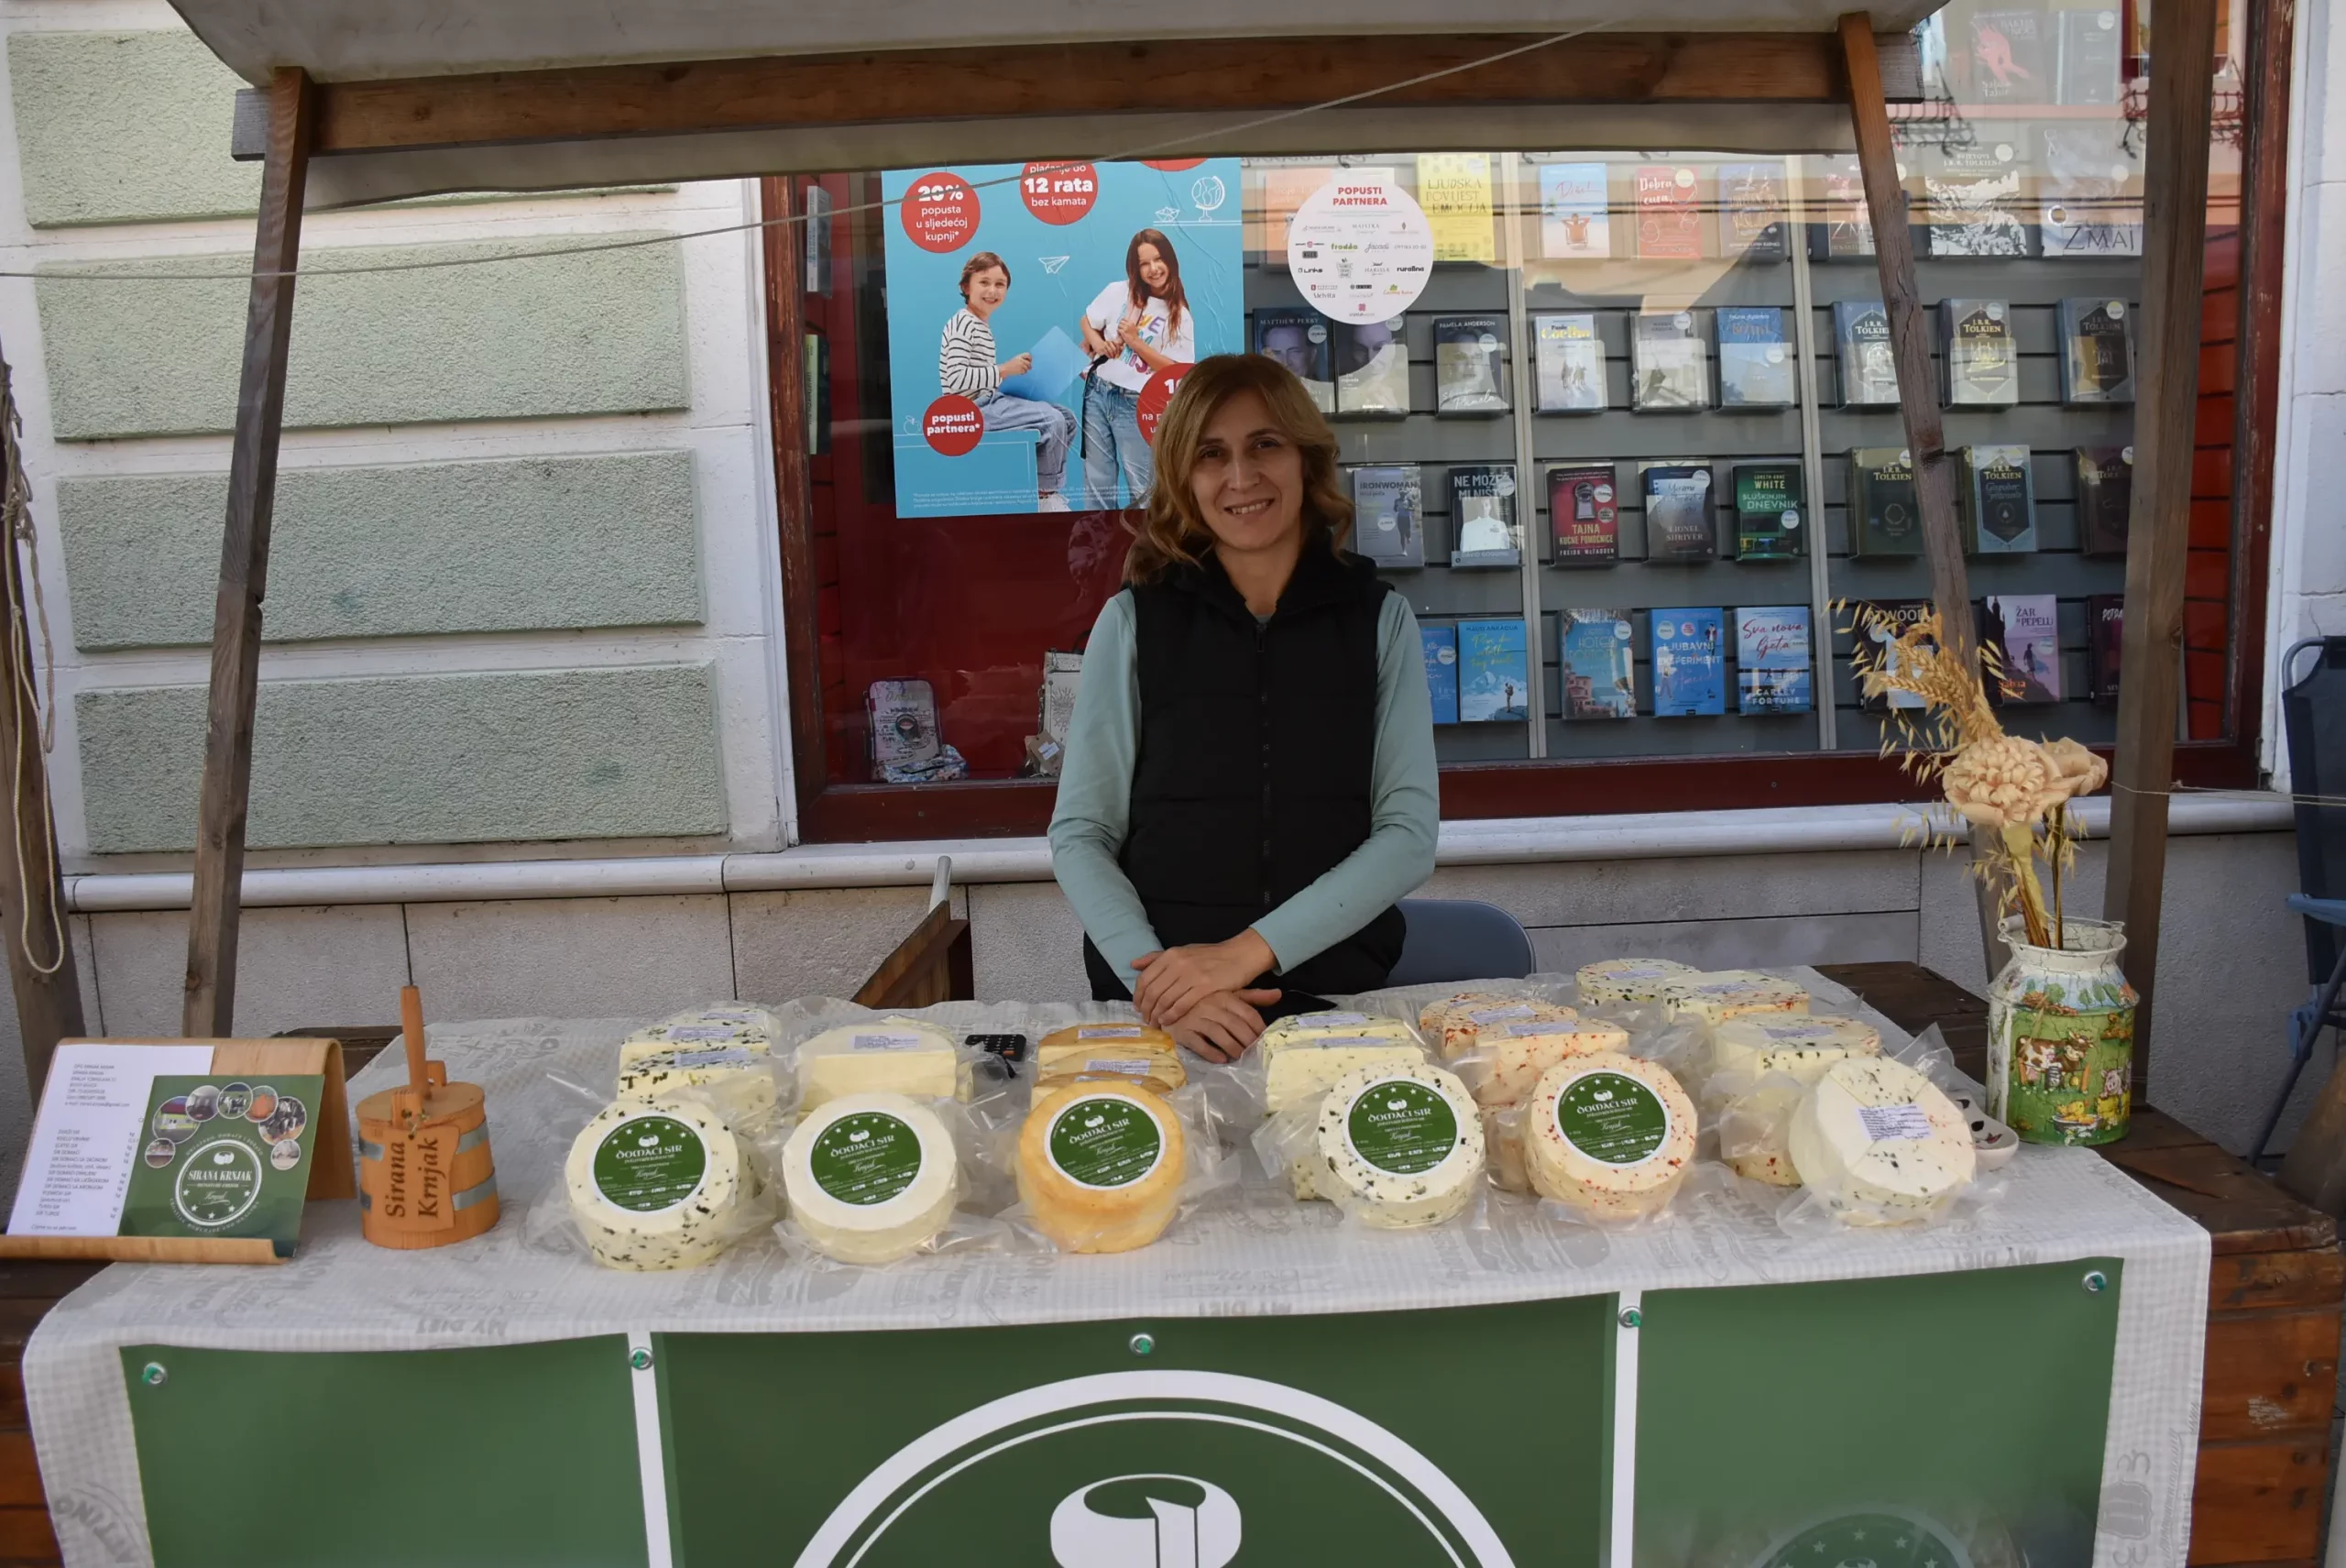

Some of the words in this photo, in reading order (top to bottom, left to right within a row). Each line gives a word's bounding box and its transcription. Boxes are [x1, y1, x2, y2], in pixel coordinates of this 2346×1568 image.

[1025, 178, 1048, 193] 12
[1054, 179, 1094, 194] rata
[1639, 177, 1672, 192] Dobra
[1337, 186, 1382, 195] POPUSTI
[1031, 196, 1049, 207] bez
[1051, 196, 1087, 207] kamata
[1332, 197, 1387, 206] PARTNERA
[921, 206, 961, 217] popusta
[915, 220, 923, 228] u
[924, 216, 968, 230] sljedećoj
[2063, 225, 2135, 252] ZMAJ
[1963, 324, 2001, 333] TOLKIEN
[931, 411, 975, 425] popusti
[1453, 475, 1470, 488] NE
[1873, 472, 1913, 481] TOLKIEN
[1983, 471, 2023, 481] TOLKIEN
[1359, 480, 1418, 490] IRONWOMAN
[1754, 479, 1786, 490] WHITE
[1742, 491, 1787, 501] SLUŠKINJIN
[1747, 500, 1799, 510] DNEVNIK
[1571, 523, 1601, 535] TAJNA
[1668, 524, 1699, 533] LIONEL
[1665, 533, 1705, 543] SHRIVER
[2016, 605, 2036, 618] ŽAR
[2021, 617, 2055, 628] PEPELU
[1742, 618, 1769, 640] Sva
[1771, 622, 1804, 632] nova
[1751, 696, 1801, 706] FORTUNE
[1619, 1097, 1639, 1107] SIR
[1412, 1107, 1433, 1116] SIR
[1112, 1117, 1131, 1129] SIR
[876, 1135, 895, 1145] SIR
[663, 1144, 684, 1154] SIR
[187, 1170, 218, 1181] SIRANA
[219, 1169, 253, 1182] KRNJAK
[385, 1140, 406, 1219] Sirana
[417, 1136, 447, 1219] Krnjak
